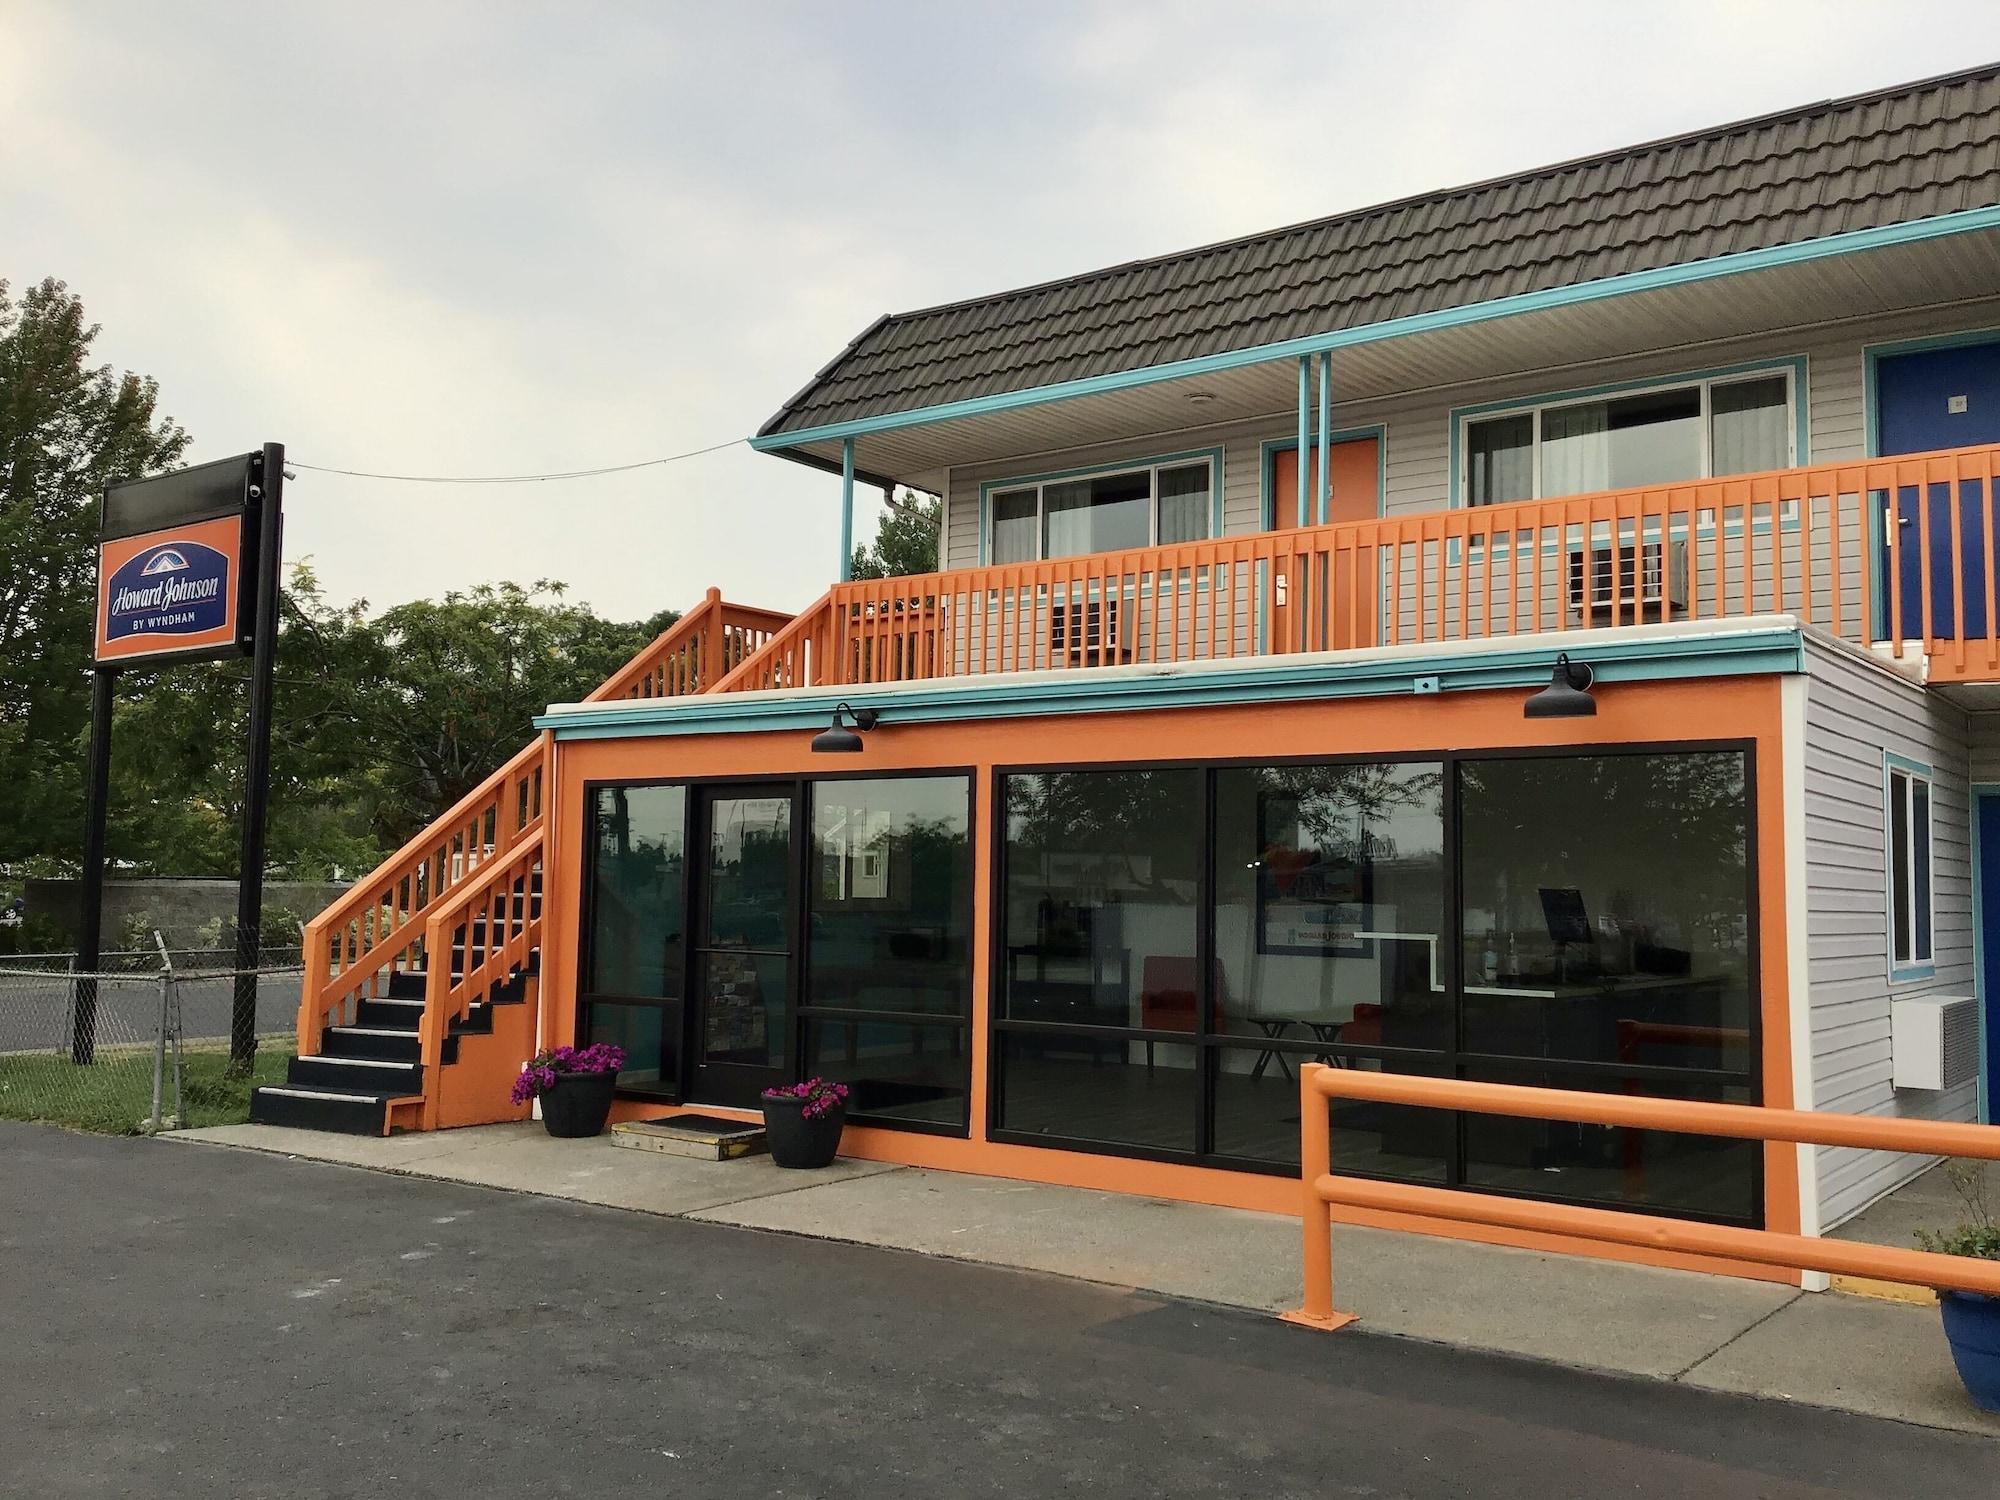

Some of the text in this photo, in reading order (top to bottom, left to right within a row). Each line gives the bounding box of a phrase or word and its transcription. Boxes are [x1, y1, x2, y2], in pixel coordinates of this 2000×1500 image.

[112, 577, 218, 616] Howard Johnson
[133, 612, 195, 630] BY WYNDHAM
